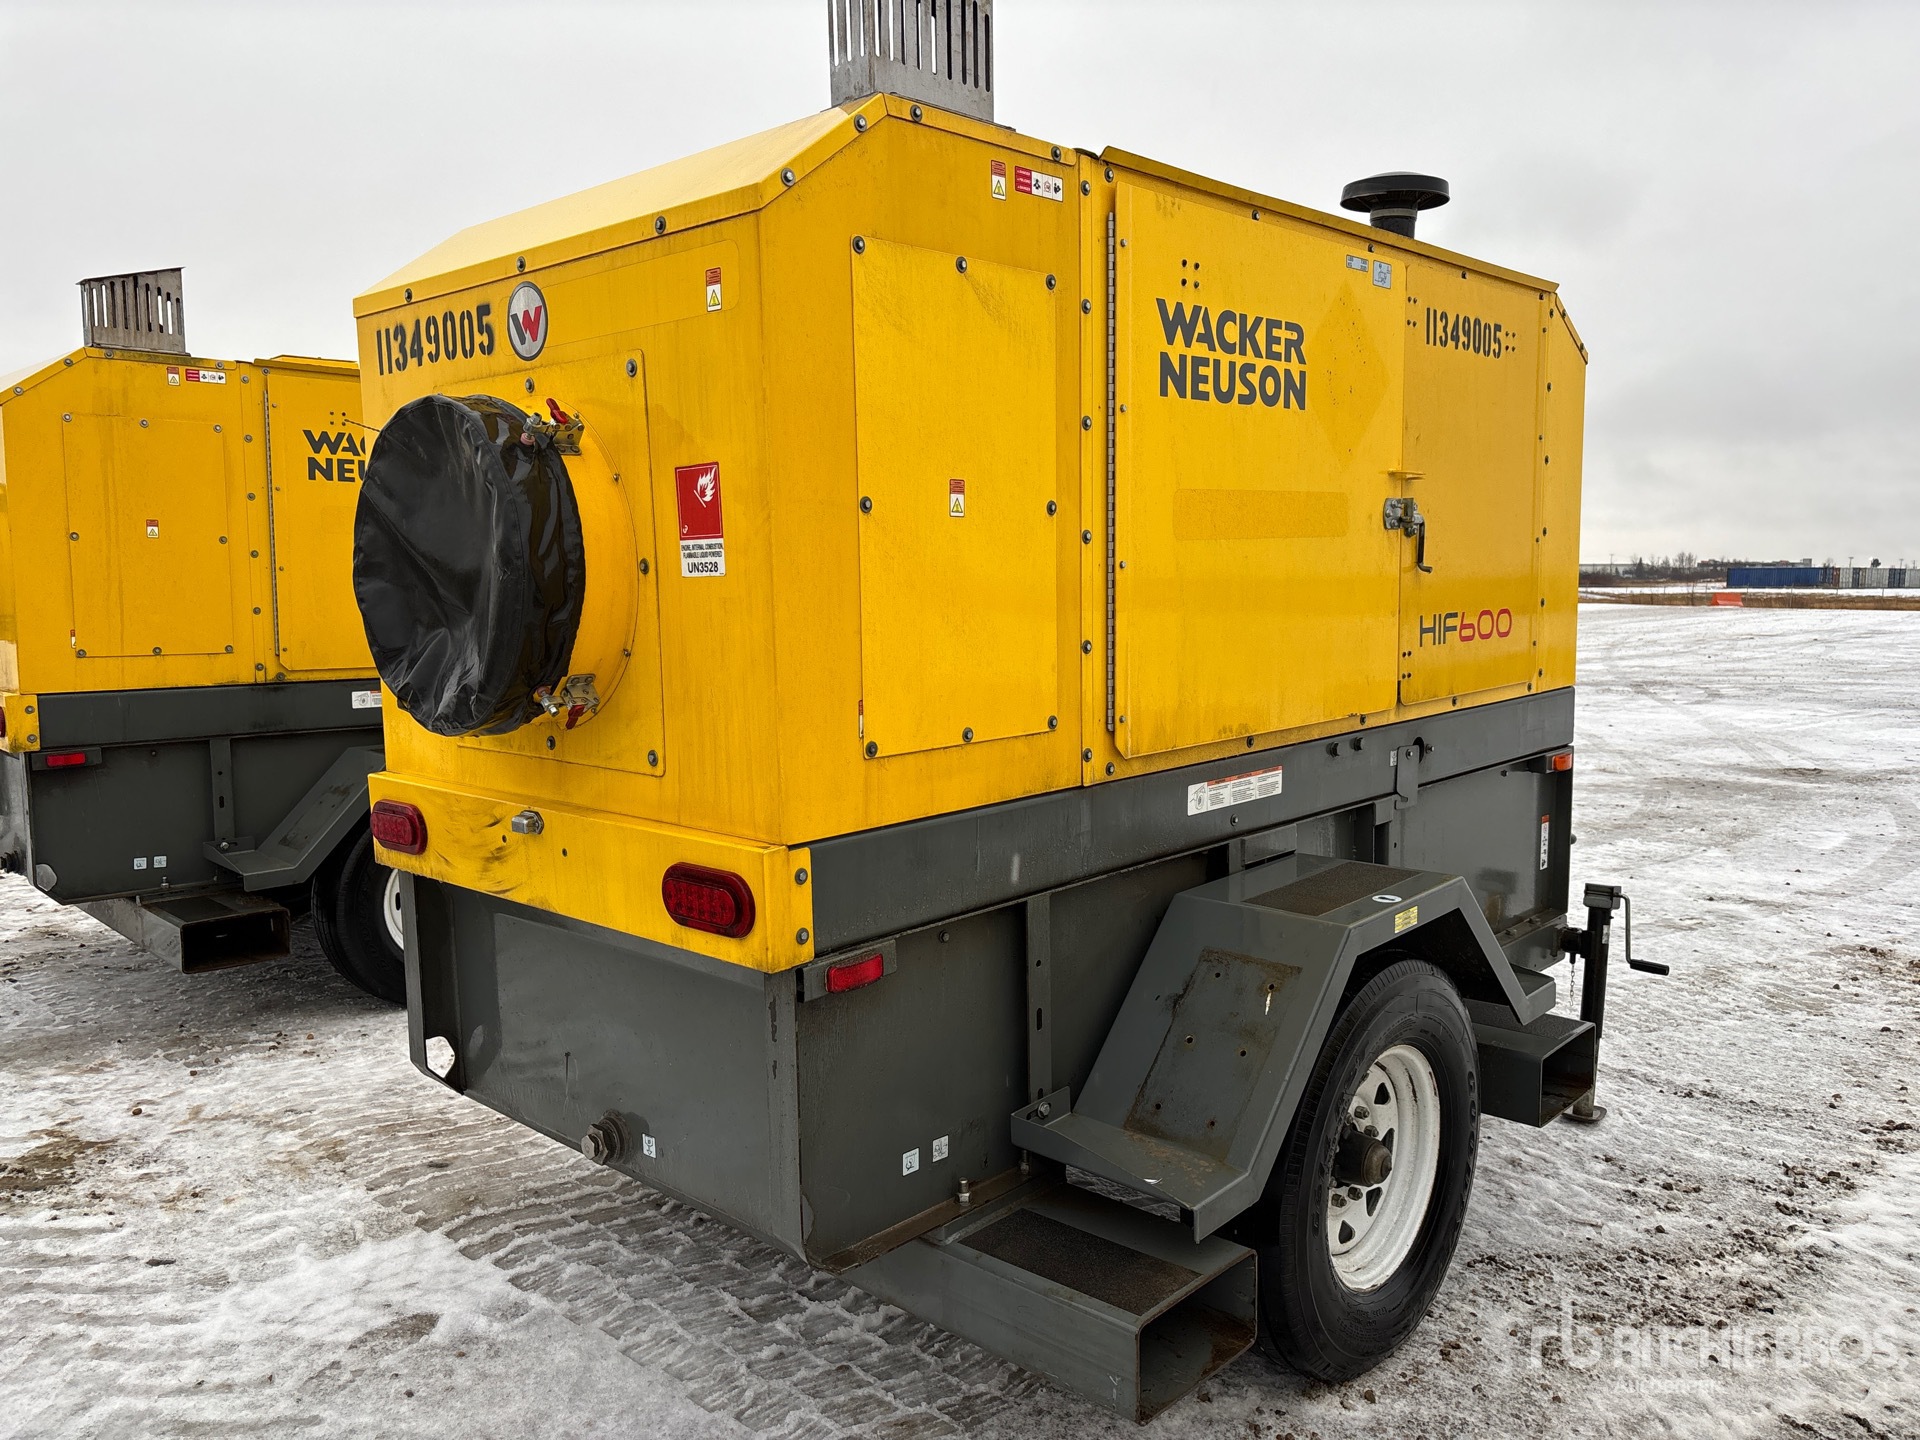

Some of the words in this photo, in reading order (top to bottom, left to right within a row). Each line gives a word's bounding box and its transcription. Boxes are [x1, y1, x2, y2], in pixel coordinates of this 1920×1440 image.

[376, 303, 495, 376] 11349005
[510, 305, 543, 346] W
[1156, 297, 1307, 366] WACKER
[1426, 307, 1502, 359] 11349005
[1159, 351, 1307, 411] NEUSON
[687, 561, 719, 573] UN3528
[1419, 608, 1513, 648] HIF600
